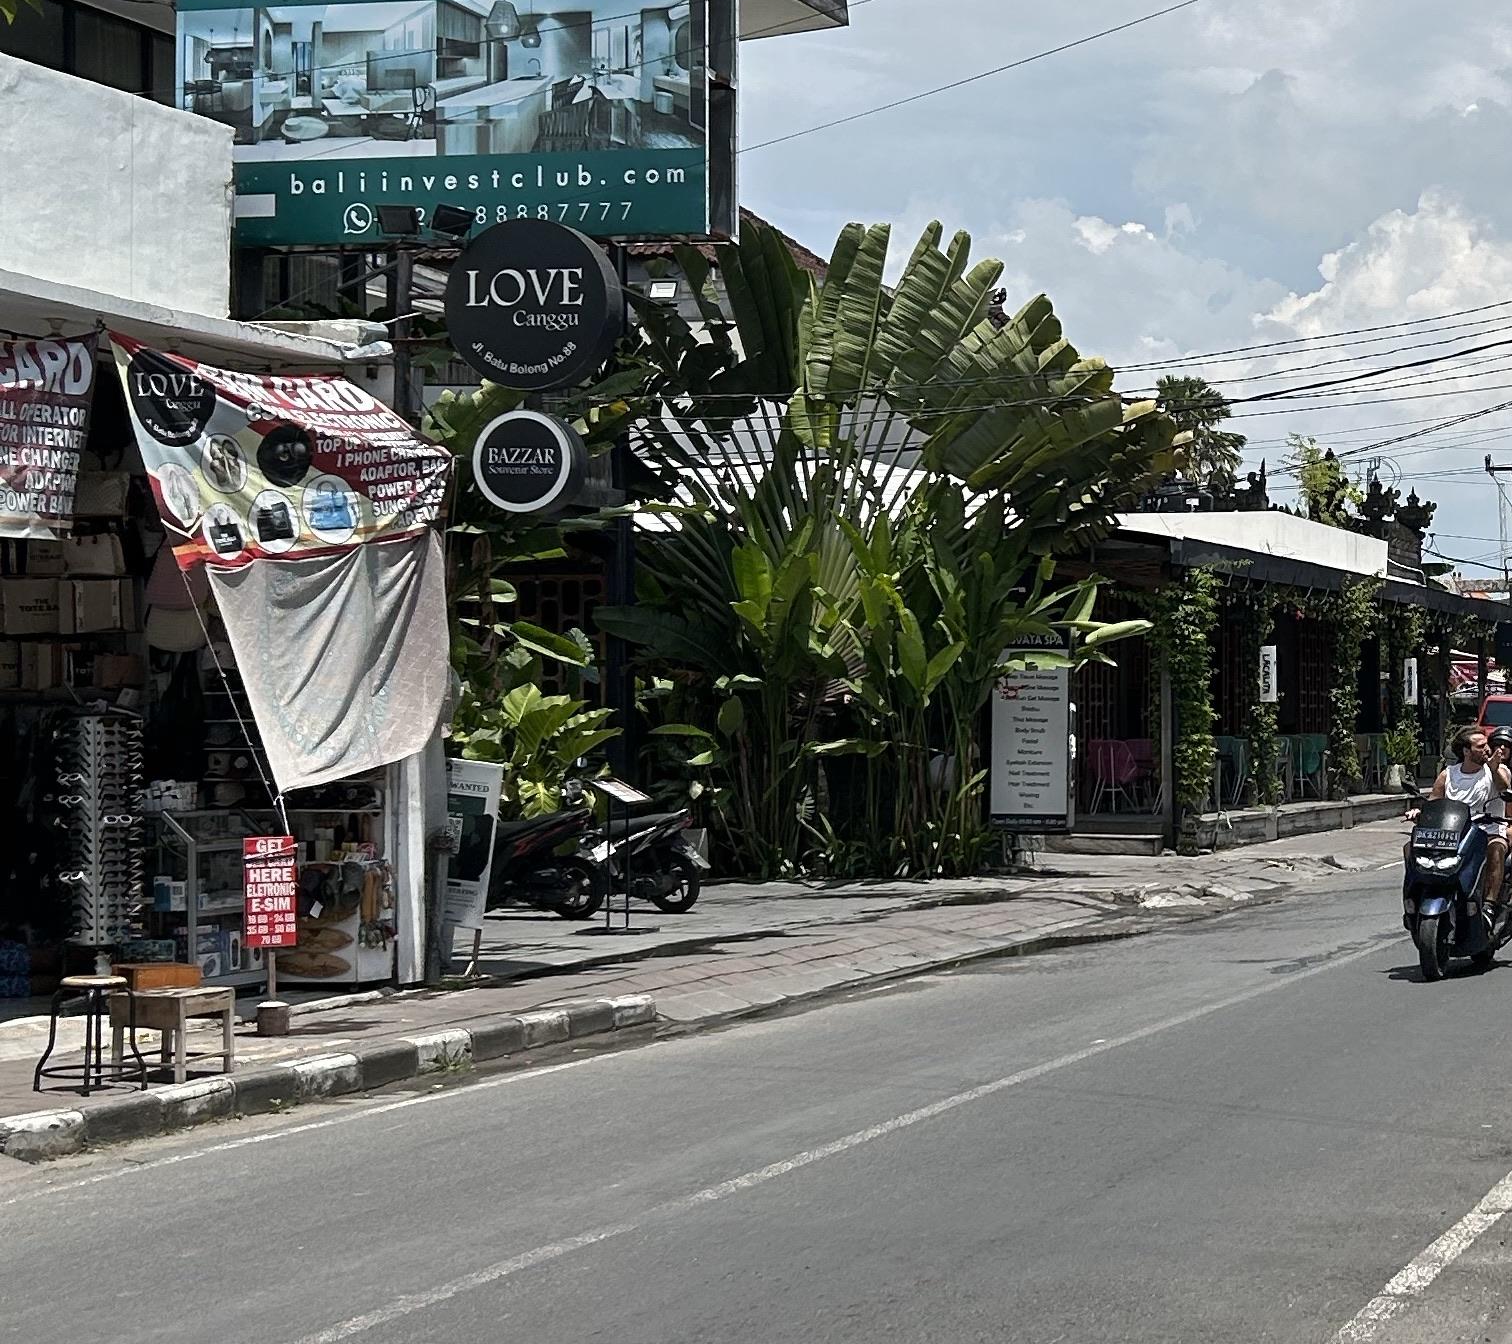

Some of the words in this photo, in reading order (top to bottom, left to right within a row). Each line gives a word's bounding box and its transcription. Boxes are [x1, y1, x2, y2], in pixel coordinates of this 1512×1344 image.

[290, 164, 686, 195] baliinvestclub.com
[465, 267, 585, 307] LOVE
[512, 309, 580, 332] Canggu
[483, 351, 508, 372] Batu
[509, 362, 549, 375] Bolong
[135, 372, 205, 397] LOVE
[270, 376, 375, 412] CARD
[20, 403, 88, 427] OPERATOR
[22, 425, 85, 449] INTERNET
[315, 437, 342, 454] TOP
[21, 448, 81, 471] CHANGER
[344, 448, 389, 467] PHONE
[487, 447, 555, 464] BAZZAR
[529, 464, 554, 475] Store
[367, 480, 413, 500] POWER
[1043, 633, 1064, 646] SPA
[450, 782, 490, 794] WANTED
[255, 839, 284, 853] GET
[249, 867, 293, 883] HERE
[246, 881, 296, 899] ELETRONIC
[251, 897, 291, 913] E-SIM
